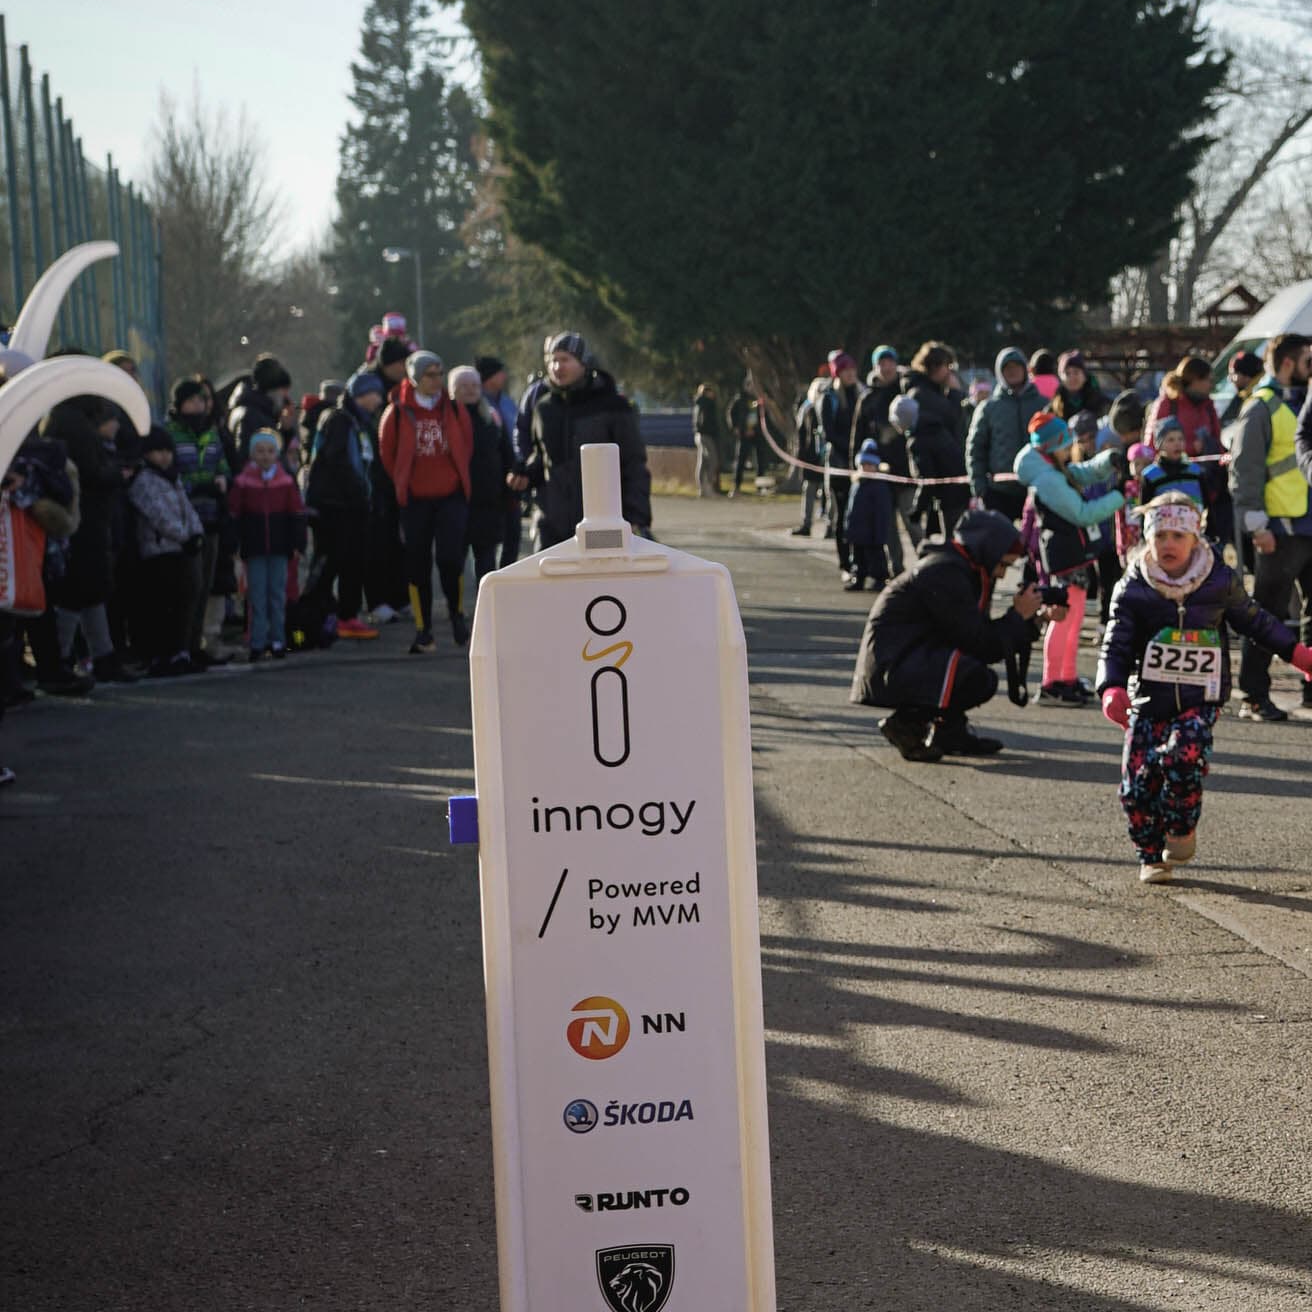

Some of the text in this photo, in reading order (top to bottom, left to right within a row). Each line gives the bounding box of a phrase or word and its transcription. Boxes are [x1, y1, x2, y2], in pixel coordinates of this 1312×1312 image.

[1148, 645, 1215, 673] 3252
[532, 796, 696, 836] innogy
[588, 872, 701, 900] Powered
[589, 902, 701, 934] by MVM
[641, 1012, 687, 1035] NN
[603, 1098, 695, 1127] ŠKODA
[597, 1187, 690, 1212] RUNTO
[603, 1250, 667, 1263] PEUGEOT
